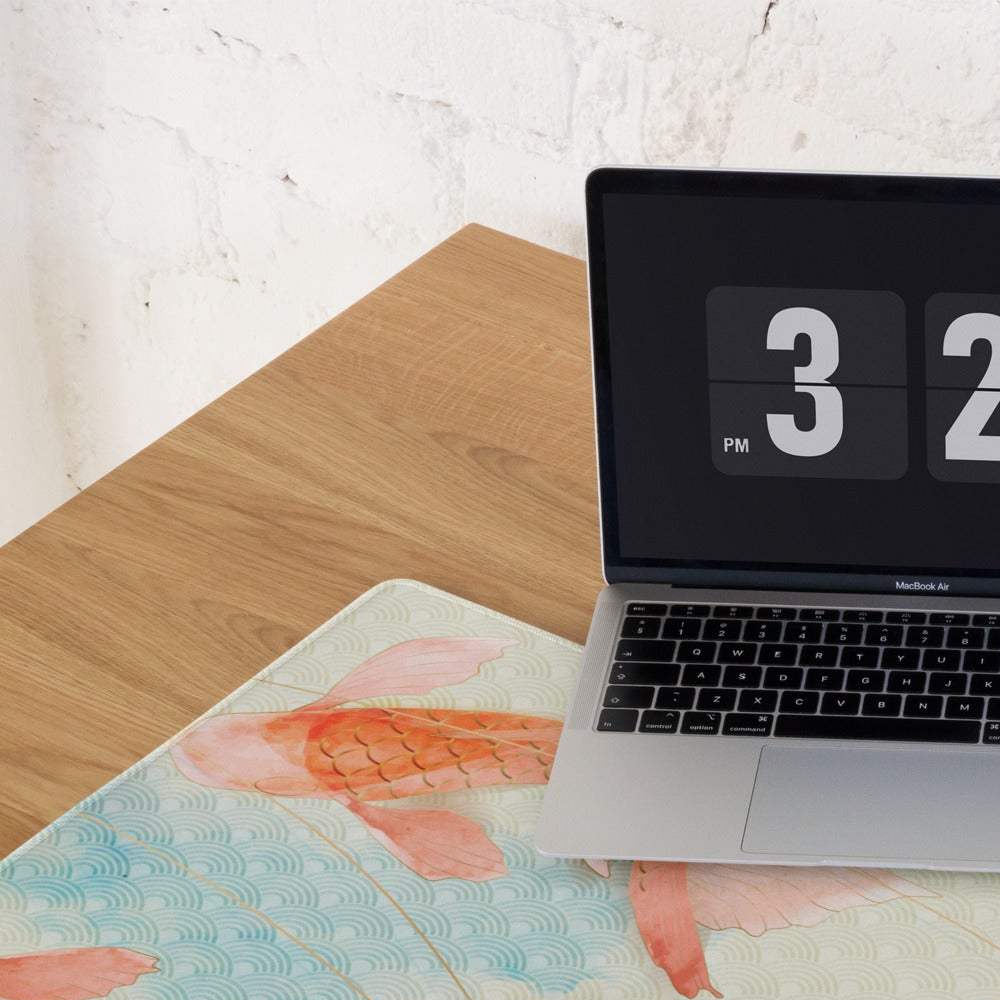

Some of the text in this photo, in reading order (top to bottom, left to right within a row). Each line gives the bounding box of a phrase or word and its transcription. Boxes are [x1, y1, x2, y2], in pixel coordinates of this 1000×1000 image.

[766, 307, 843, 457] 3
[723, 437, 749, 453] PM
[896, 581, 949, 590] MacBook Air
[692, 648, 701, 656] Q
